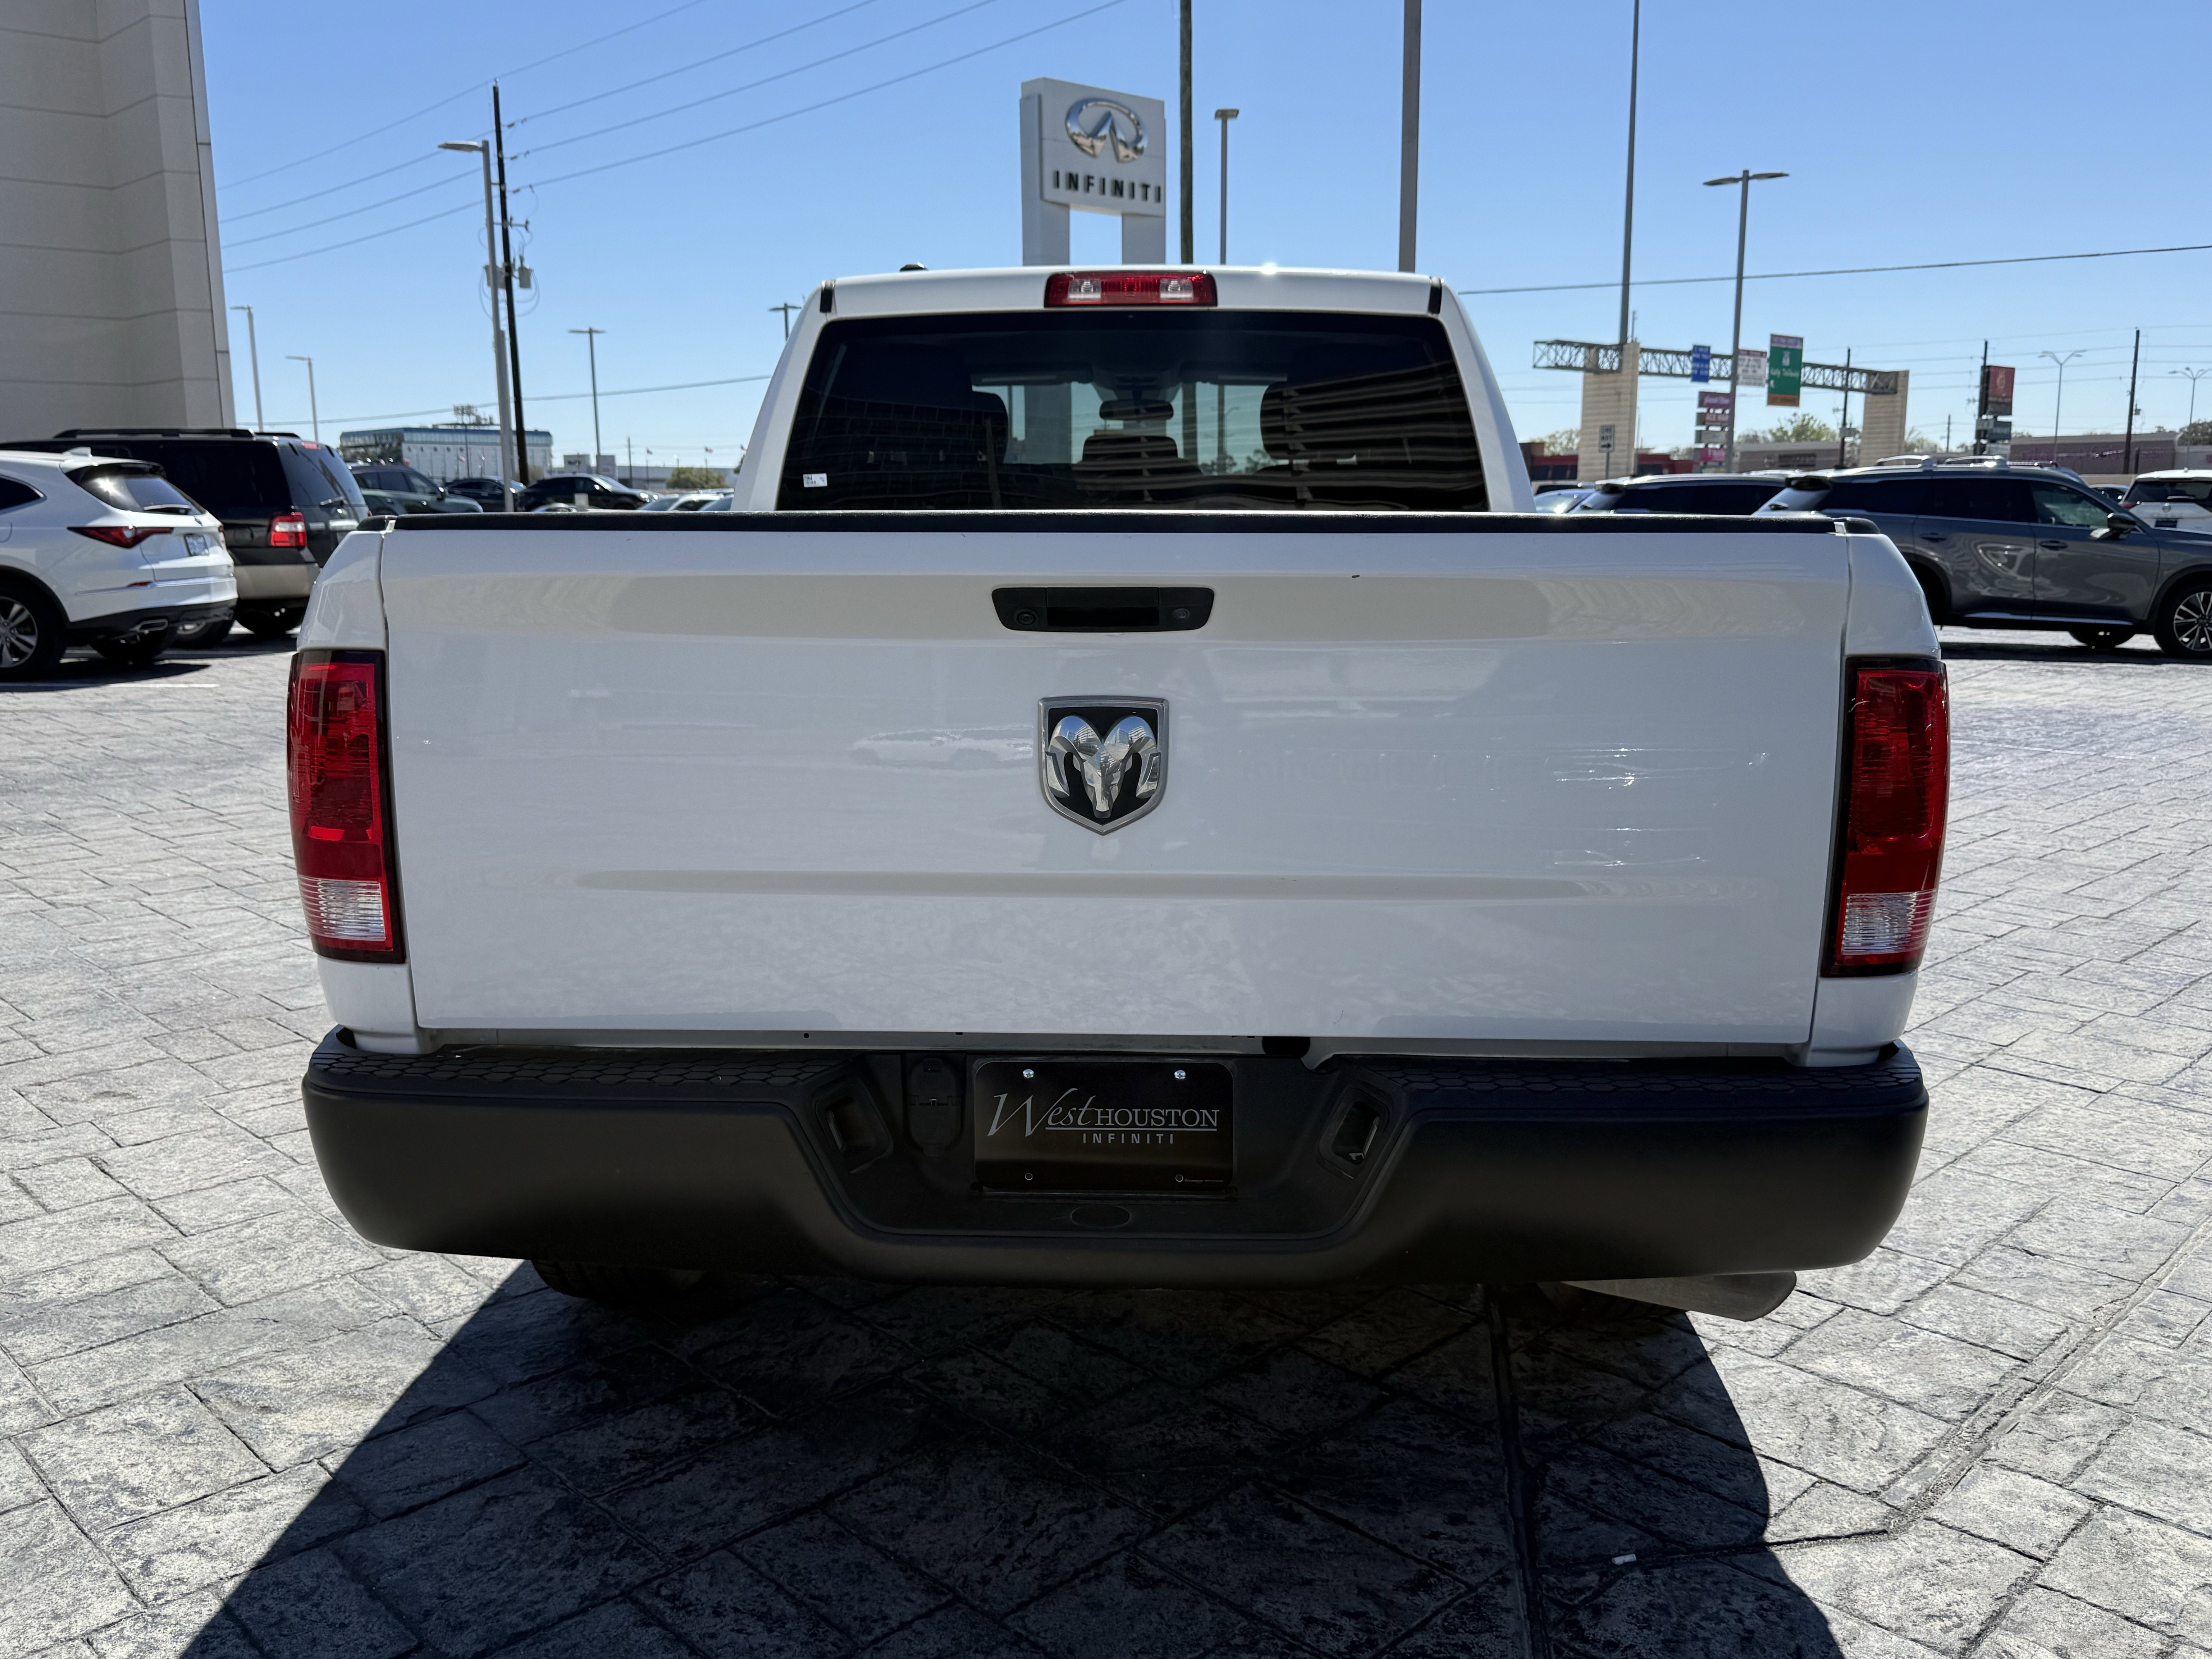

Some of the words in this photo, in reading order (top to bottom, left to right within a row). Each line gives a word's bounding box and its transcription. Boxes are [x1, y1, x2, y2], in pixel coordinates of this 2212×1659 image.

[1054, 170, 1161, 203] INFINITI
[987, 1087, 1096, 1137] West
[1095, 1108, 1219, 1127] HOUSTON
[1083, 1133, 1174, 1144] INFINITI
